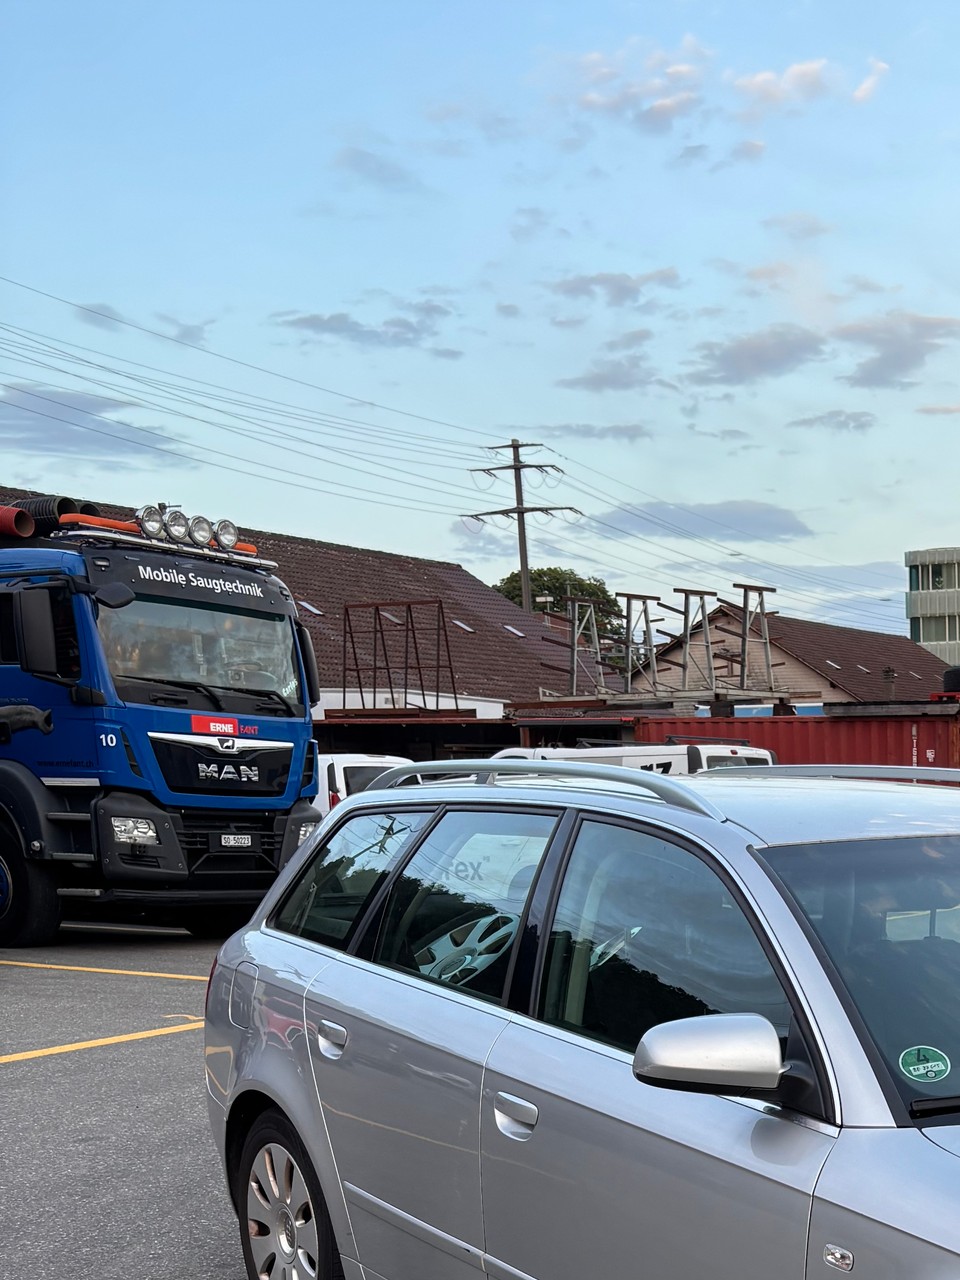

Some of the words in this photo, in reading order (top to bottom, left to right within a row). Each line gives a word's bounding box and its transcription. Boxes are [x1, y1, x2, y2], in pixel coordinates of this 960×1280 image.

[138, 565, 187, 585] Mobile
[188, 573, 264, 598] Saugtechnik
[209, 722, 234, 733] ERNE
[99, 733, 117, 747] 10
[197, 763, 260, 782] MAN
